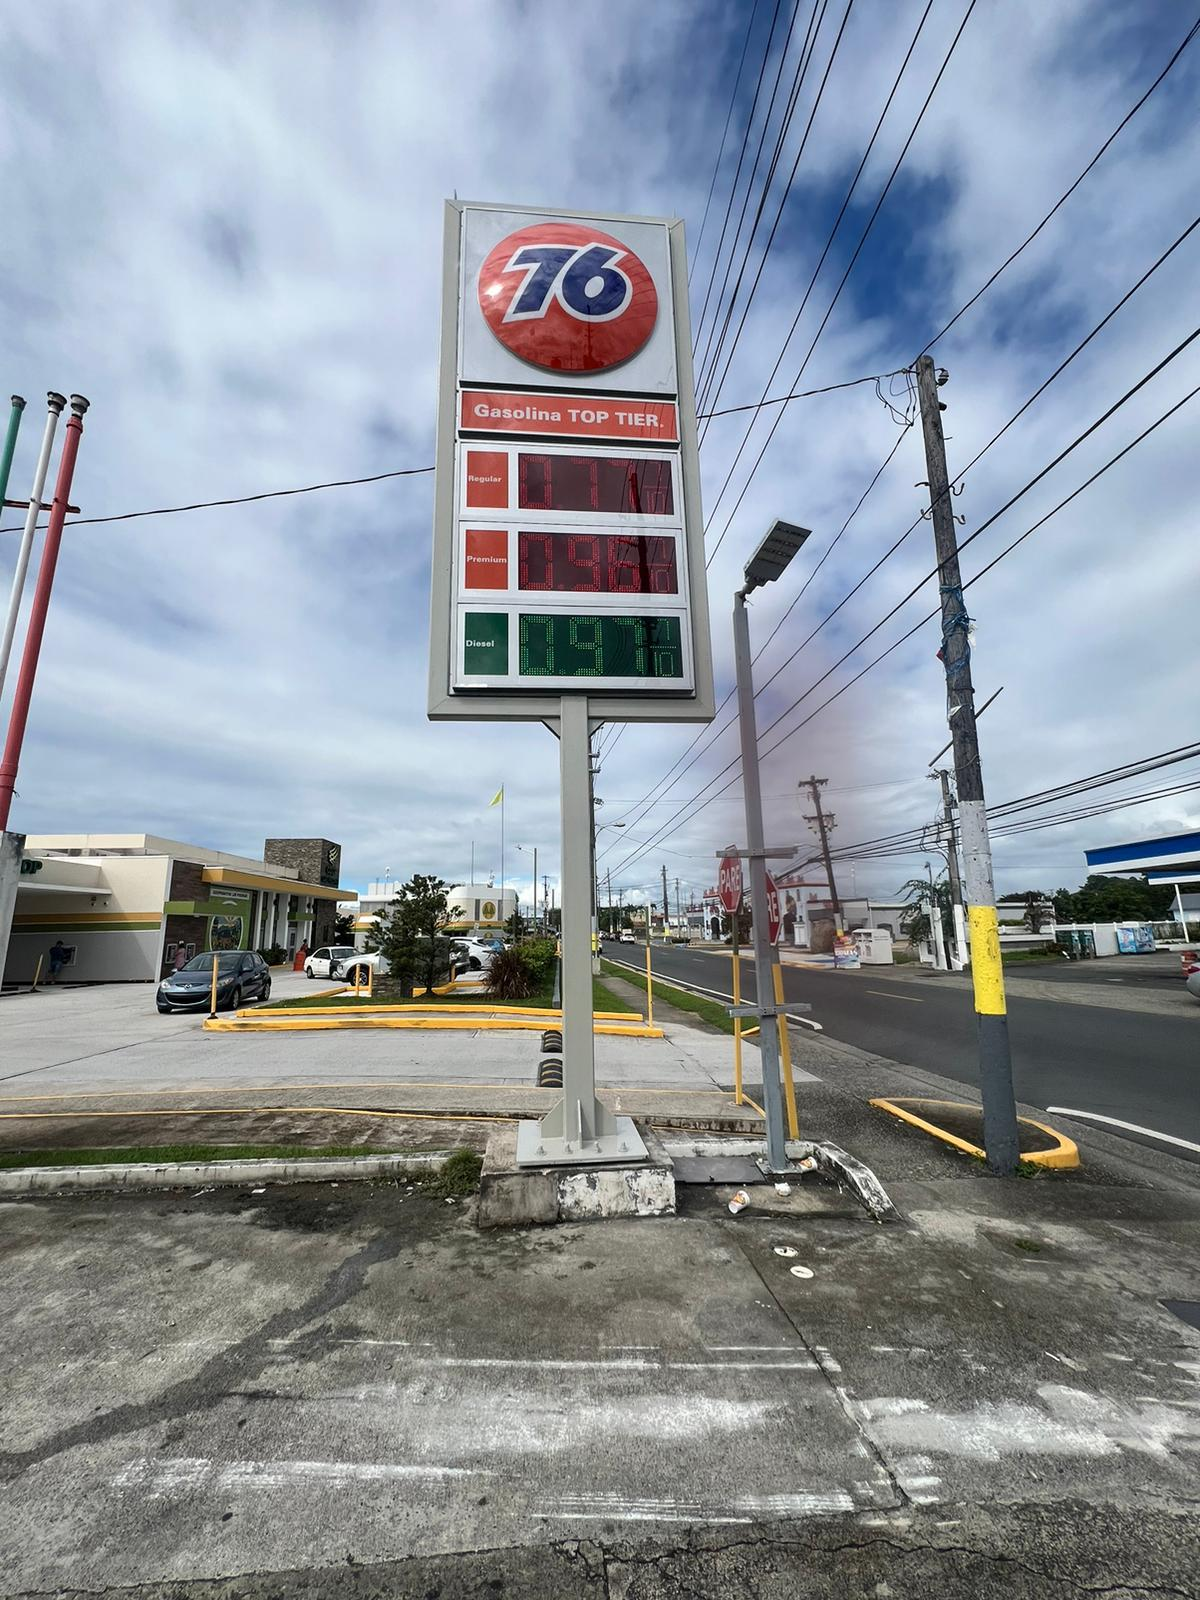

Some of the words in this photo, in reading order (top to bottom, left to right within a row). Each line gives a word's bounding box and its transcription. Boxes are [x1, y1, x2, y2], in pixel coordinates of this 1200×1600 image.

[502, 242, 633, 323] 76
[473, 403, 561, 422] Gasolina
[567, 408, 609, 424] TOP
[468, 474, 502, 483] Regular
[466, 555, 507, 563] Premium
[465, 639, 495, 647] Diesel
[720, 865, 740, 893] PARE
[766, 891, 779, 923] RE
